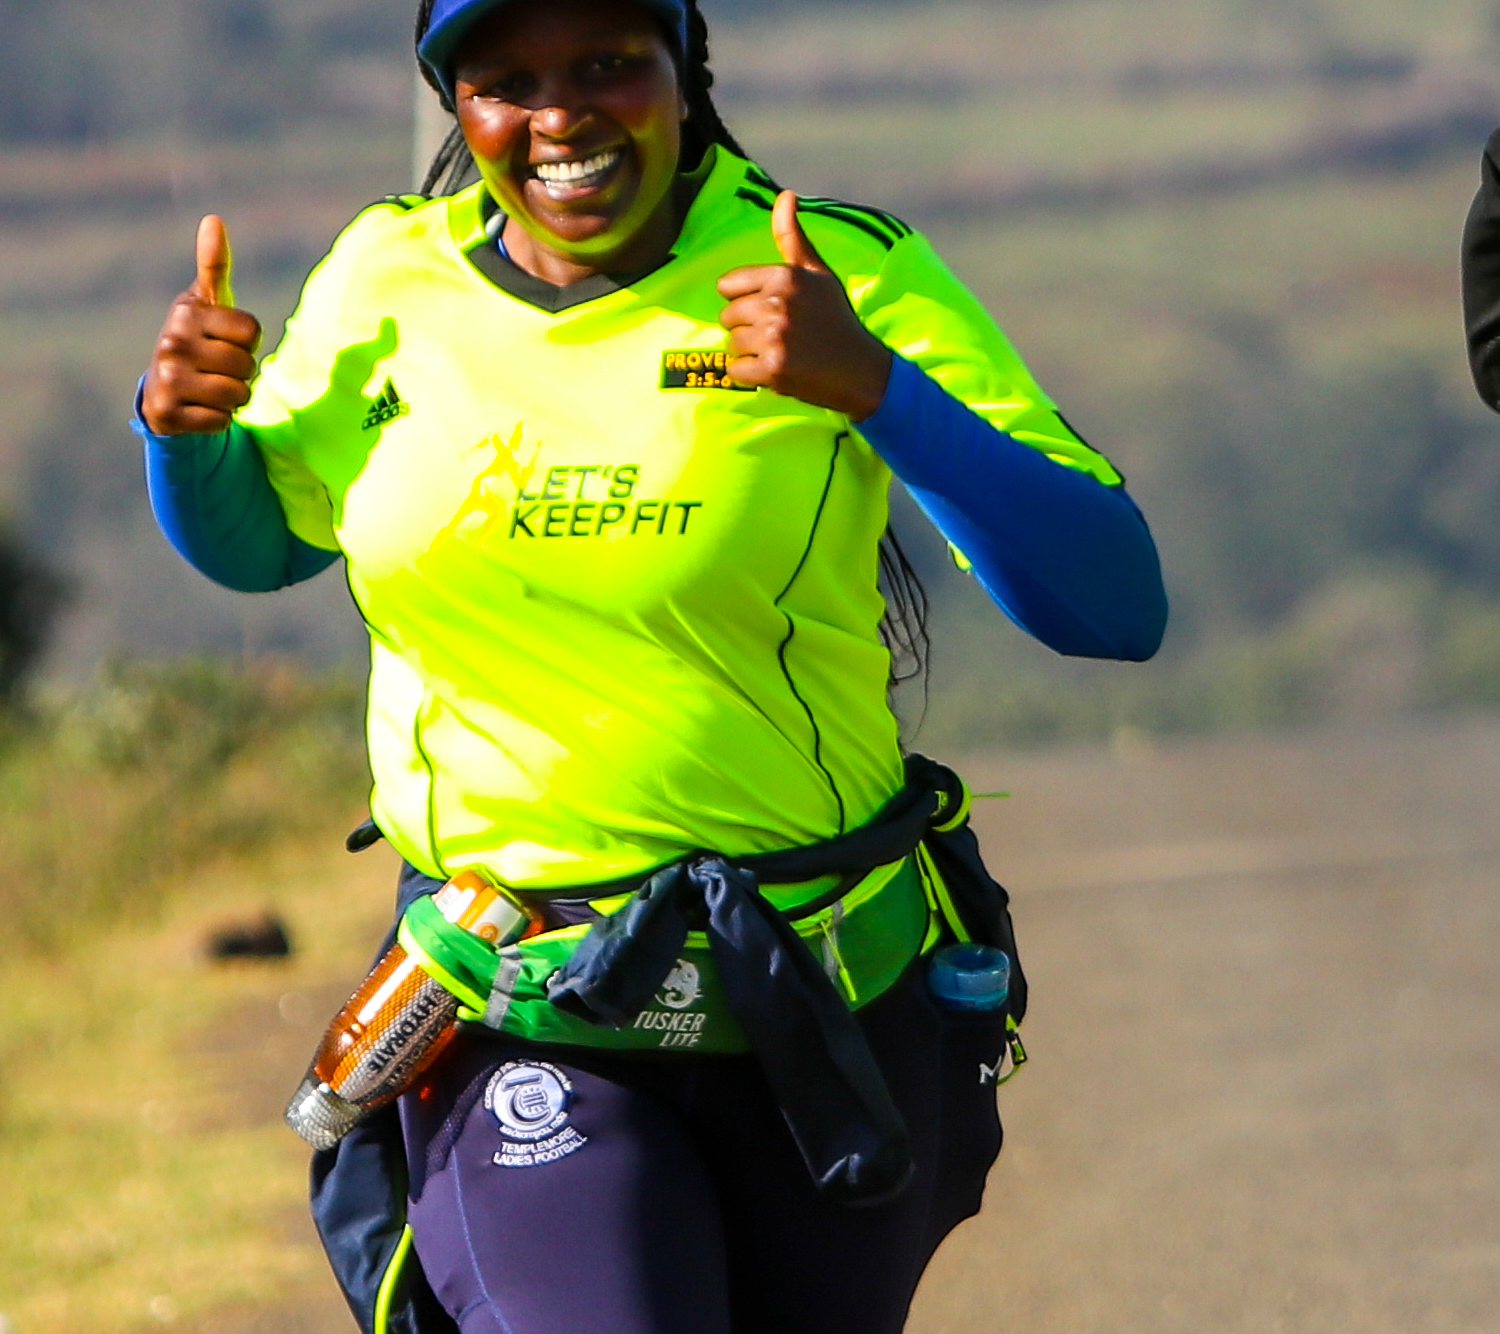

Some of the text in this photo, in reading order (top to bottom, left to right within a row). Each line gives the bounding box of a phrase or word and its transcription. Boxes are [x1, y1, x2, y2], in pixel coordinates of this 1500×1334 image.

[685, 372, 732, 387] 3:5-6
[516, 463, 640, 501] LET'S
[508, 500, 704, 539] KEEP FIT
[367, 995, 438, 1073] HYDRATE
[633, 1010, 706, 1032] TUSKER
[659, 1031, 702, 1047] LITE
[493, 1134, 588, 1166] LADIES FOOTBALL
[502, 1126, 577, 1153] TEMPLEMORE
